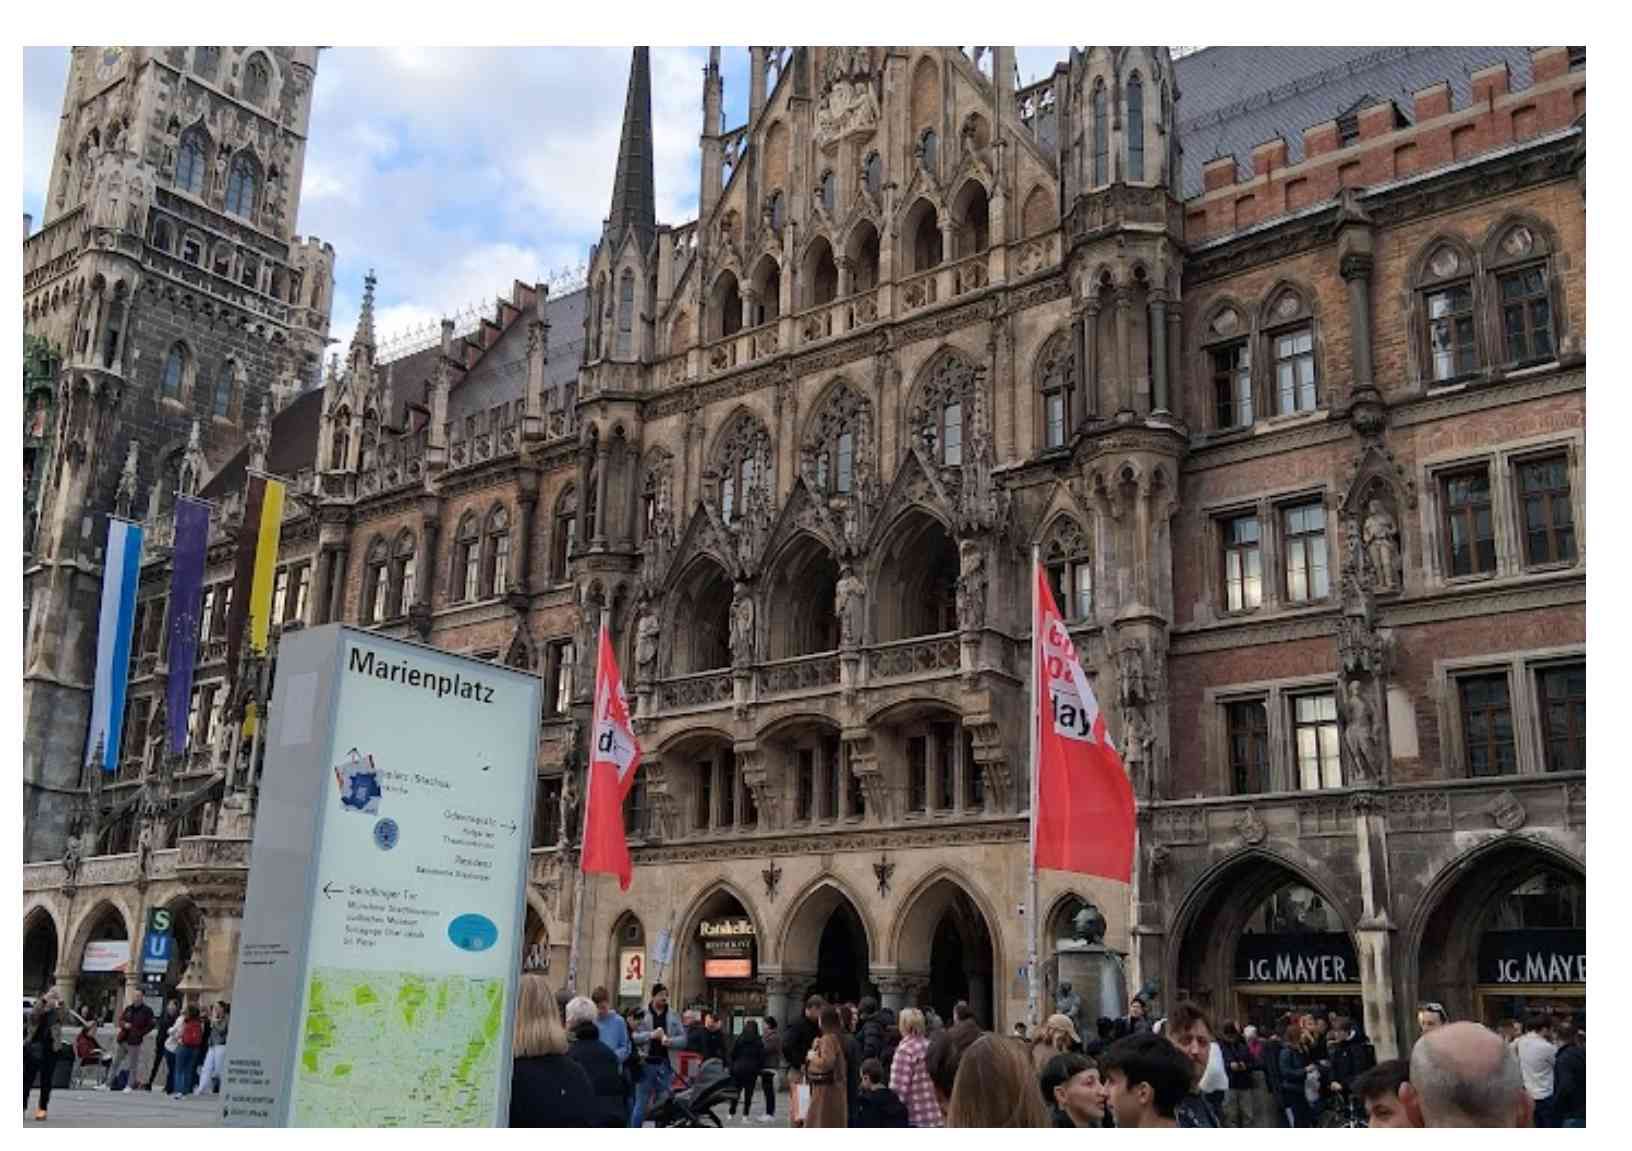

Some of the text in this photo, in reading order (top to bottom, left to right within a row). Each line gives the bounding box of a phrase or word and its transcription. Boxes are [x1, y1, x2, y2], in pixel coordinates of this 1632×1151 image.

[349, 647, 495, 704] Marienplatz
[153, 910, 170, 931] S
[151, 936, 167, 956] U
[1276, 953, 1347, 982] MAYER
